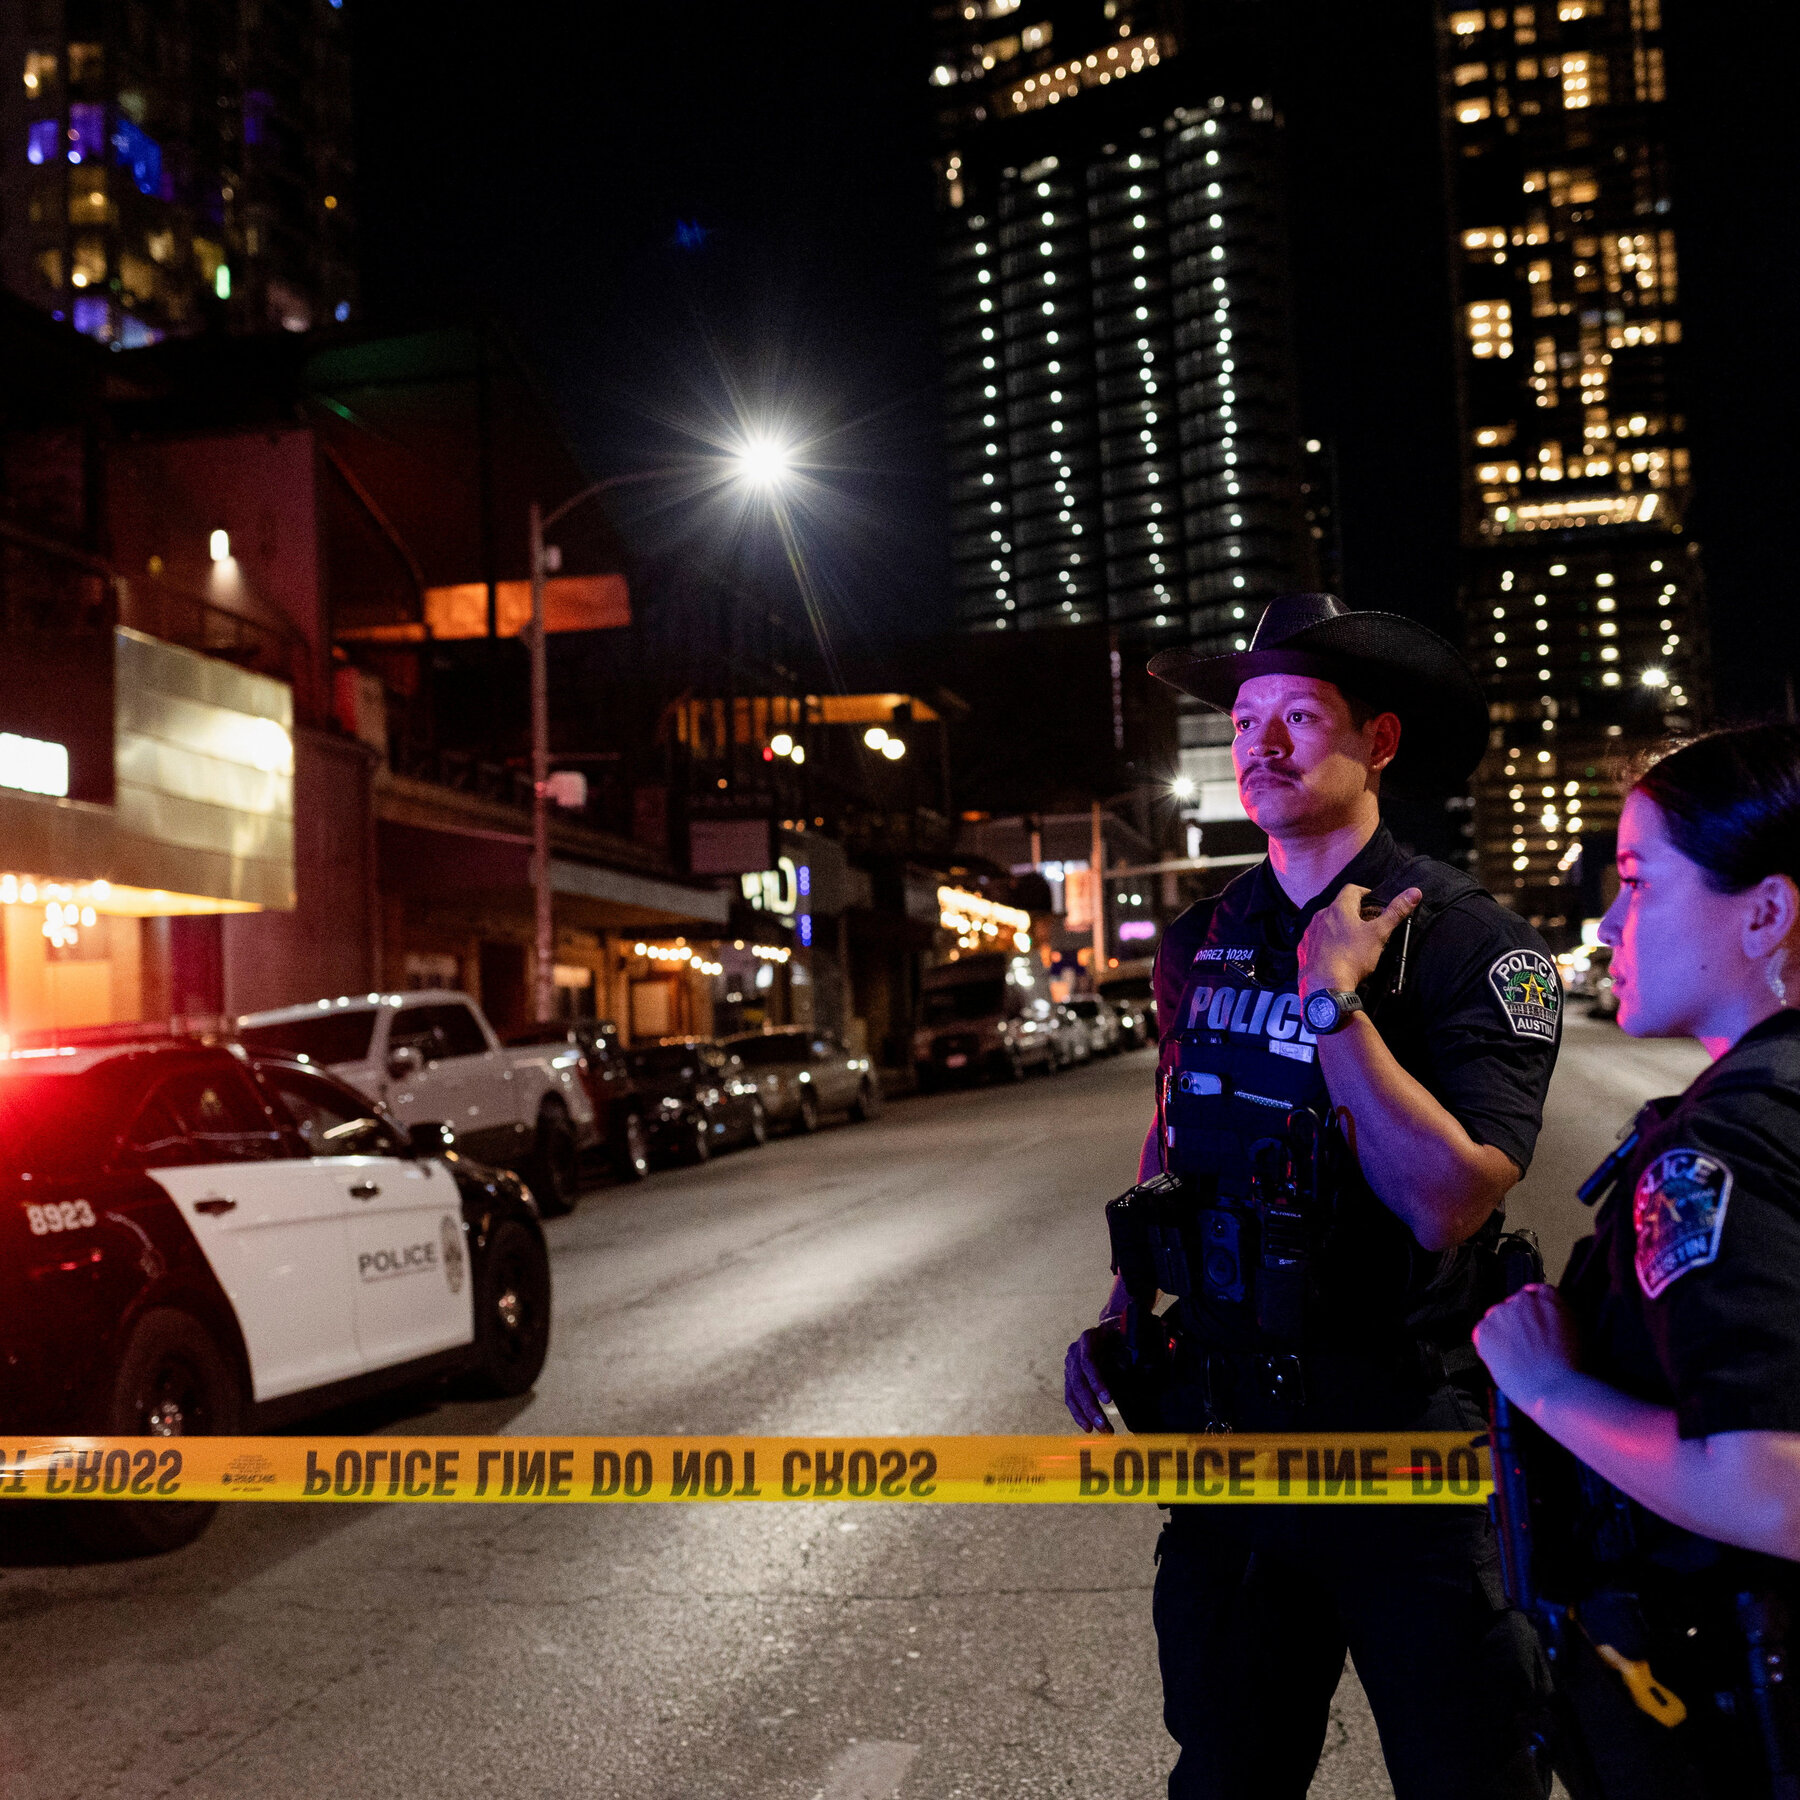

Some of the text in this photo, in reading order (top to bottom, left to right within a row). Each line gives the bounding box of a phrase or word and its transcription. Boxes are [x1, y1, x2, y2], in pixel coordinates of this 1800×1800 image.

[1226, 948, 1254, 961] 10234
[1495, 954, 1557, 993] POLICE
[1516, 1017, 1553, 1036] AUSTIN
[26, 1199, 97, 1236] 8923
[358, 1242, 438, 1275] POLICE
